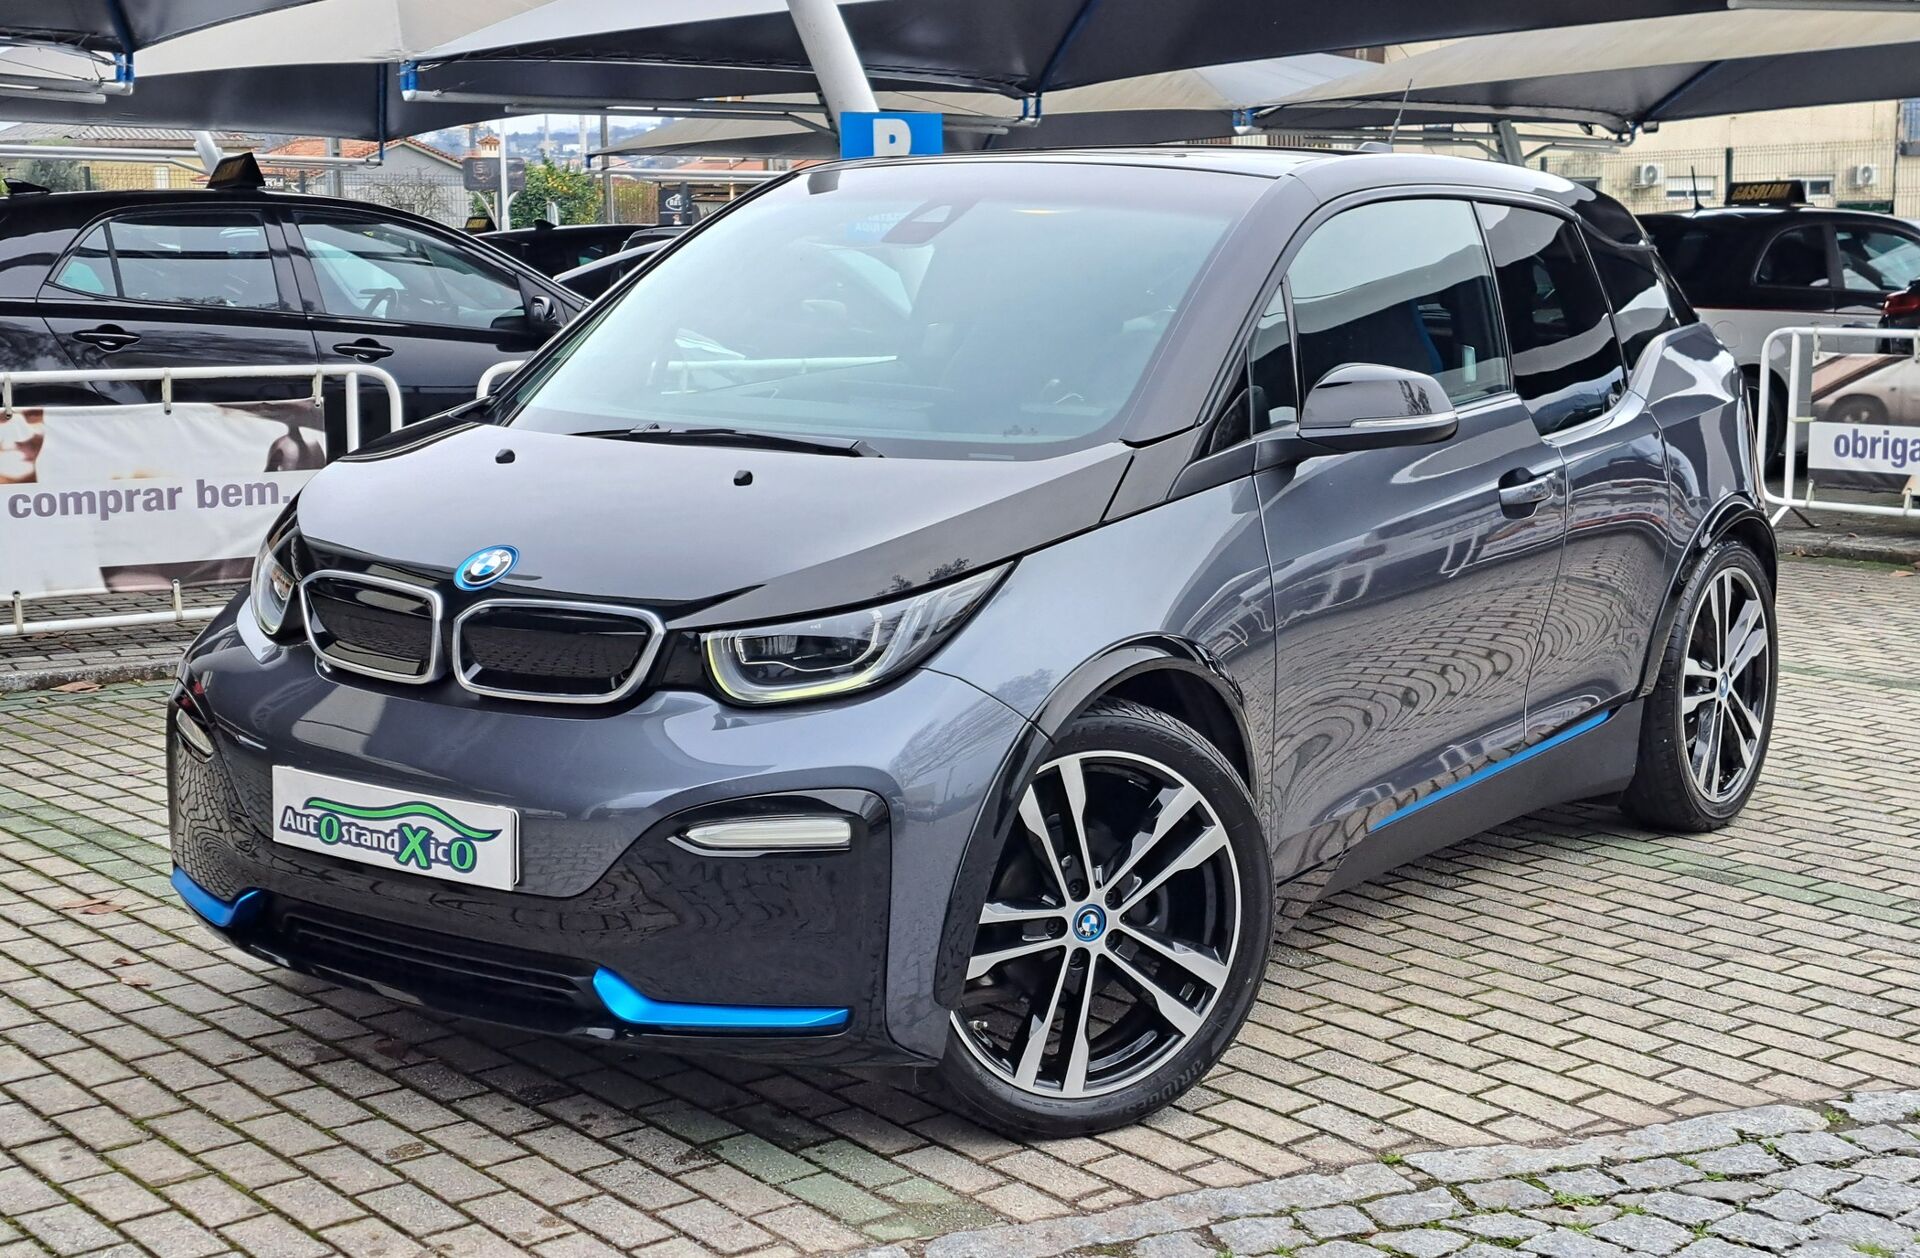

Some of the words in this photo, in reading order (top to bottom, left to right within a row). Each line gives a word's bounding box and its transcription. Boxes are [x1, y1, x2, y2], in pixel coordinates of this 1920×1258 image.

[1731, 183, 1792, 200] GASOLINA
[8, 486, 183, 521] comprar
[195, 478, 291, 509] bem.
